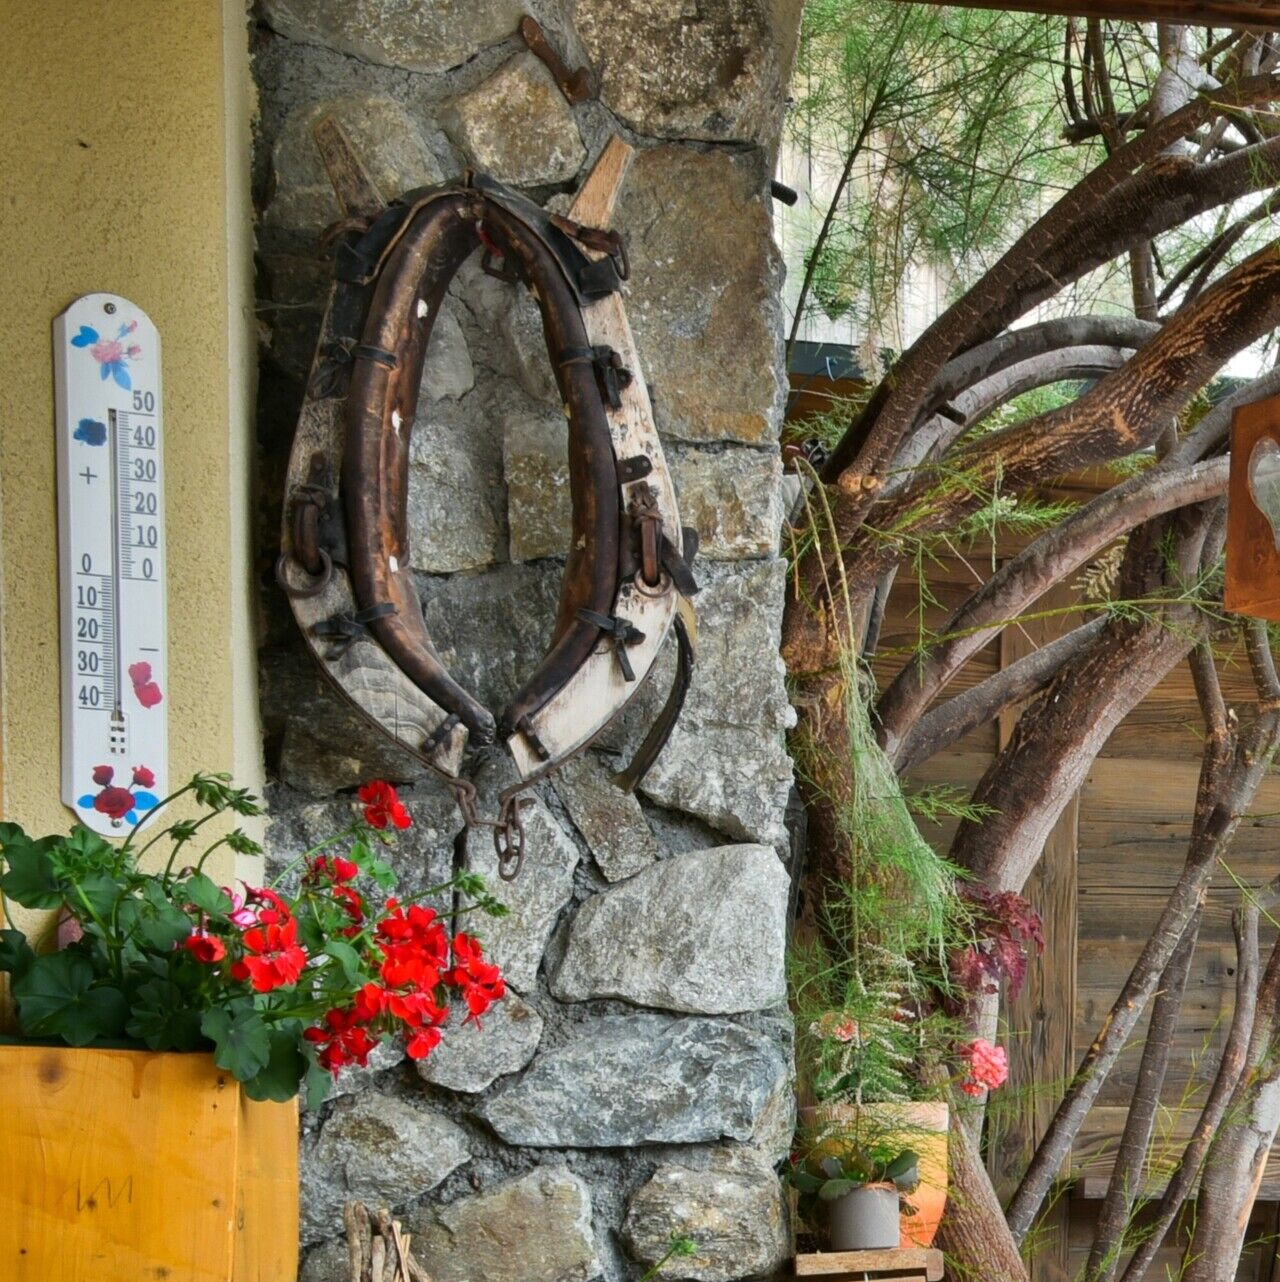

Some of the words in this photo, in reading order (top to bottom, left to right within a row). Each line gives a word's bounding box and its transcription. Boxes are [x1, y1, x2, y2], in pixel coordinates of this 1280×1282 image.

[133, 390, 155, 412] 50
[133, 426, 156, 447] 40
[134, 459, 156, 480] 30
[135, 491, 157, 513] 20
[136, 525, 157, 546] 10
[81, 553, 92, 573] 0
[142, 558, 153, 578] 0
[77, 586, 98, 606] 10
[77, 617, 98, 639] 20
[77, 651, 99, 672] 30
[78, 685, 99, 706] 40
